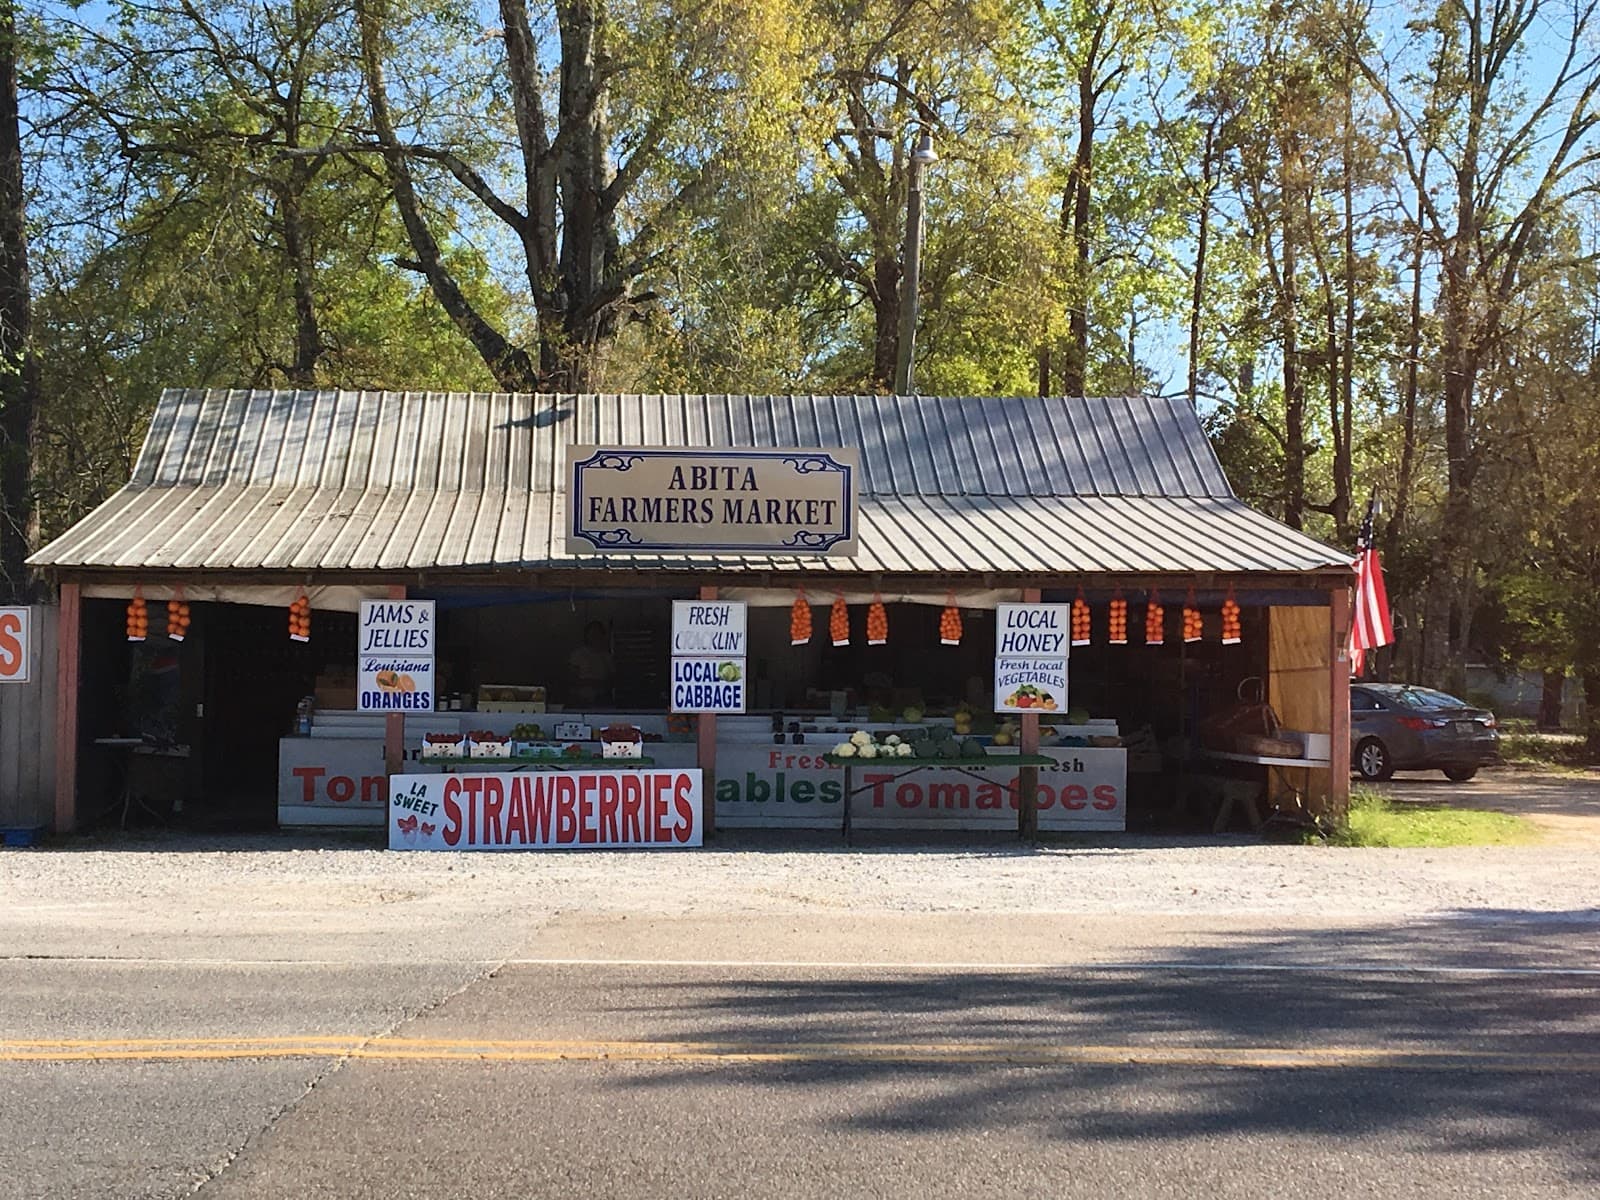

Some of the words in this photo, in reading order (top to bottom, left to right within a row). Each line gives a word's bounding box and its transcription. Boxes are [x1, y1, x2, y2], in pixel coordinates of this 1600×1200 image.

[668, 465, 759, 491] ABITA
[588, 496, 713, 524] FARMERS
[722, 498, 837, 526] MARKET
[364, 604, 414, 626] JAMS
[419, 609, 429, 624] &
[689, 605, 730, 626] FRESH
[1007, 610, 1058, 629] LOCAL
[0, 613, 22, 677] S
[364, 629, 429, 651] JELLIES
[1001, 632, 1064, 652] HONEY
[362, 659, 431, 672] Louisiana
[675, 662, 720, 682] LOCAL
[1000, 660, 1029, 670] Fresh
[1033, 660, 1063, 670] Local
[999, 672, 1065, 689] VEGETABLES
[362, 691, 430, 709] ORANGES
[675, 685, 741, 708] CABBAGE
[410, 782, 427, 798] LA
[394, 793, 439, 816] SWEET
[442, 773, 693, 847] STRAWBERRIES
